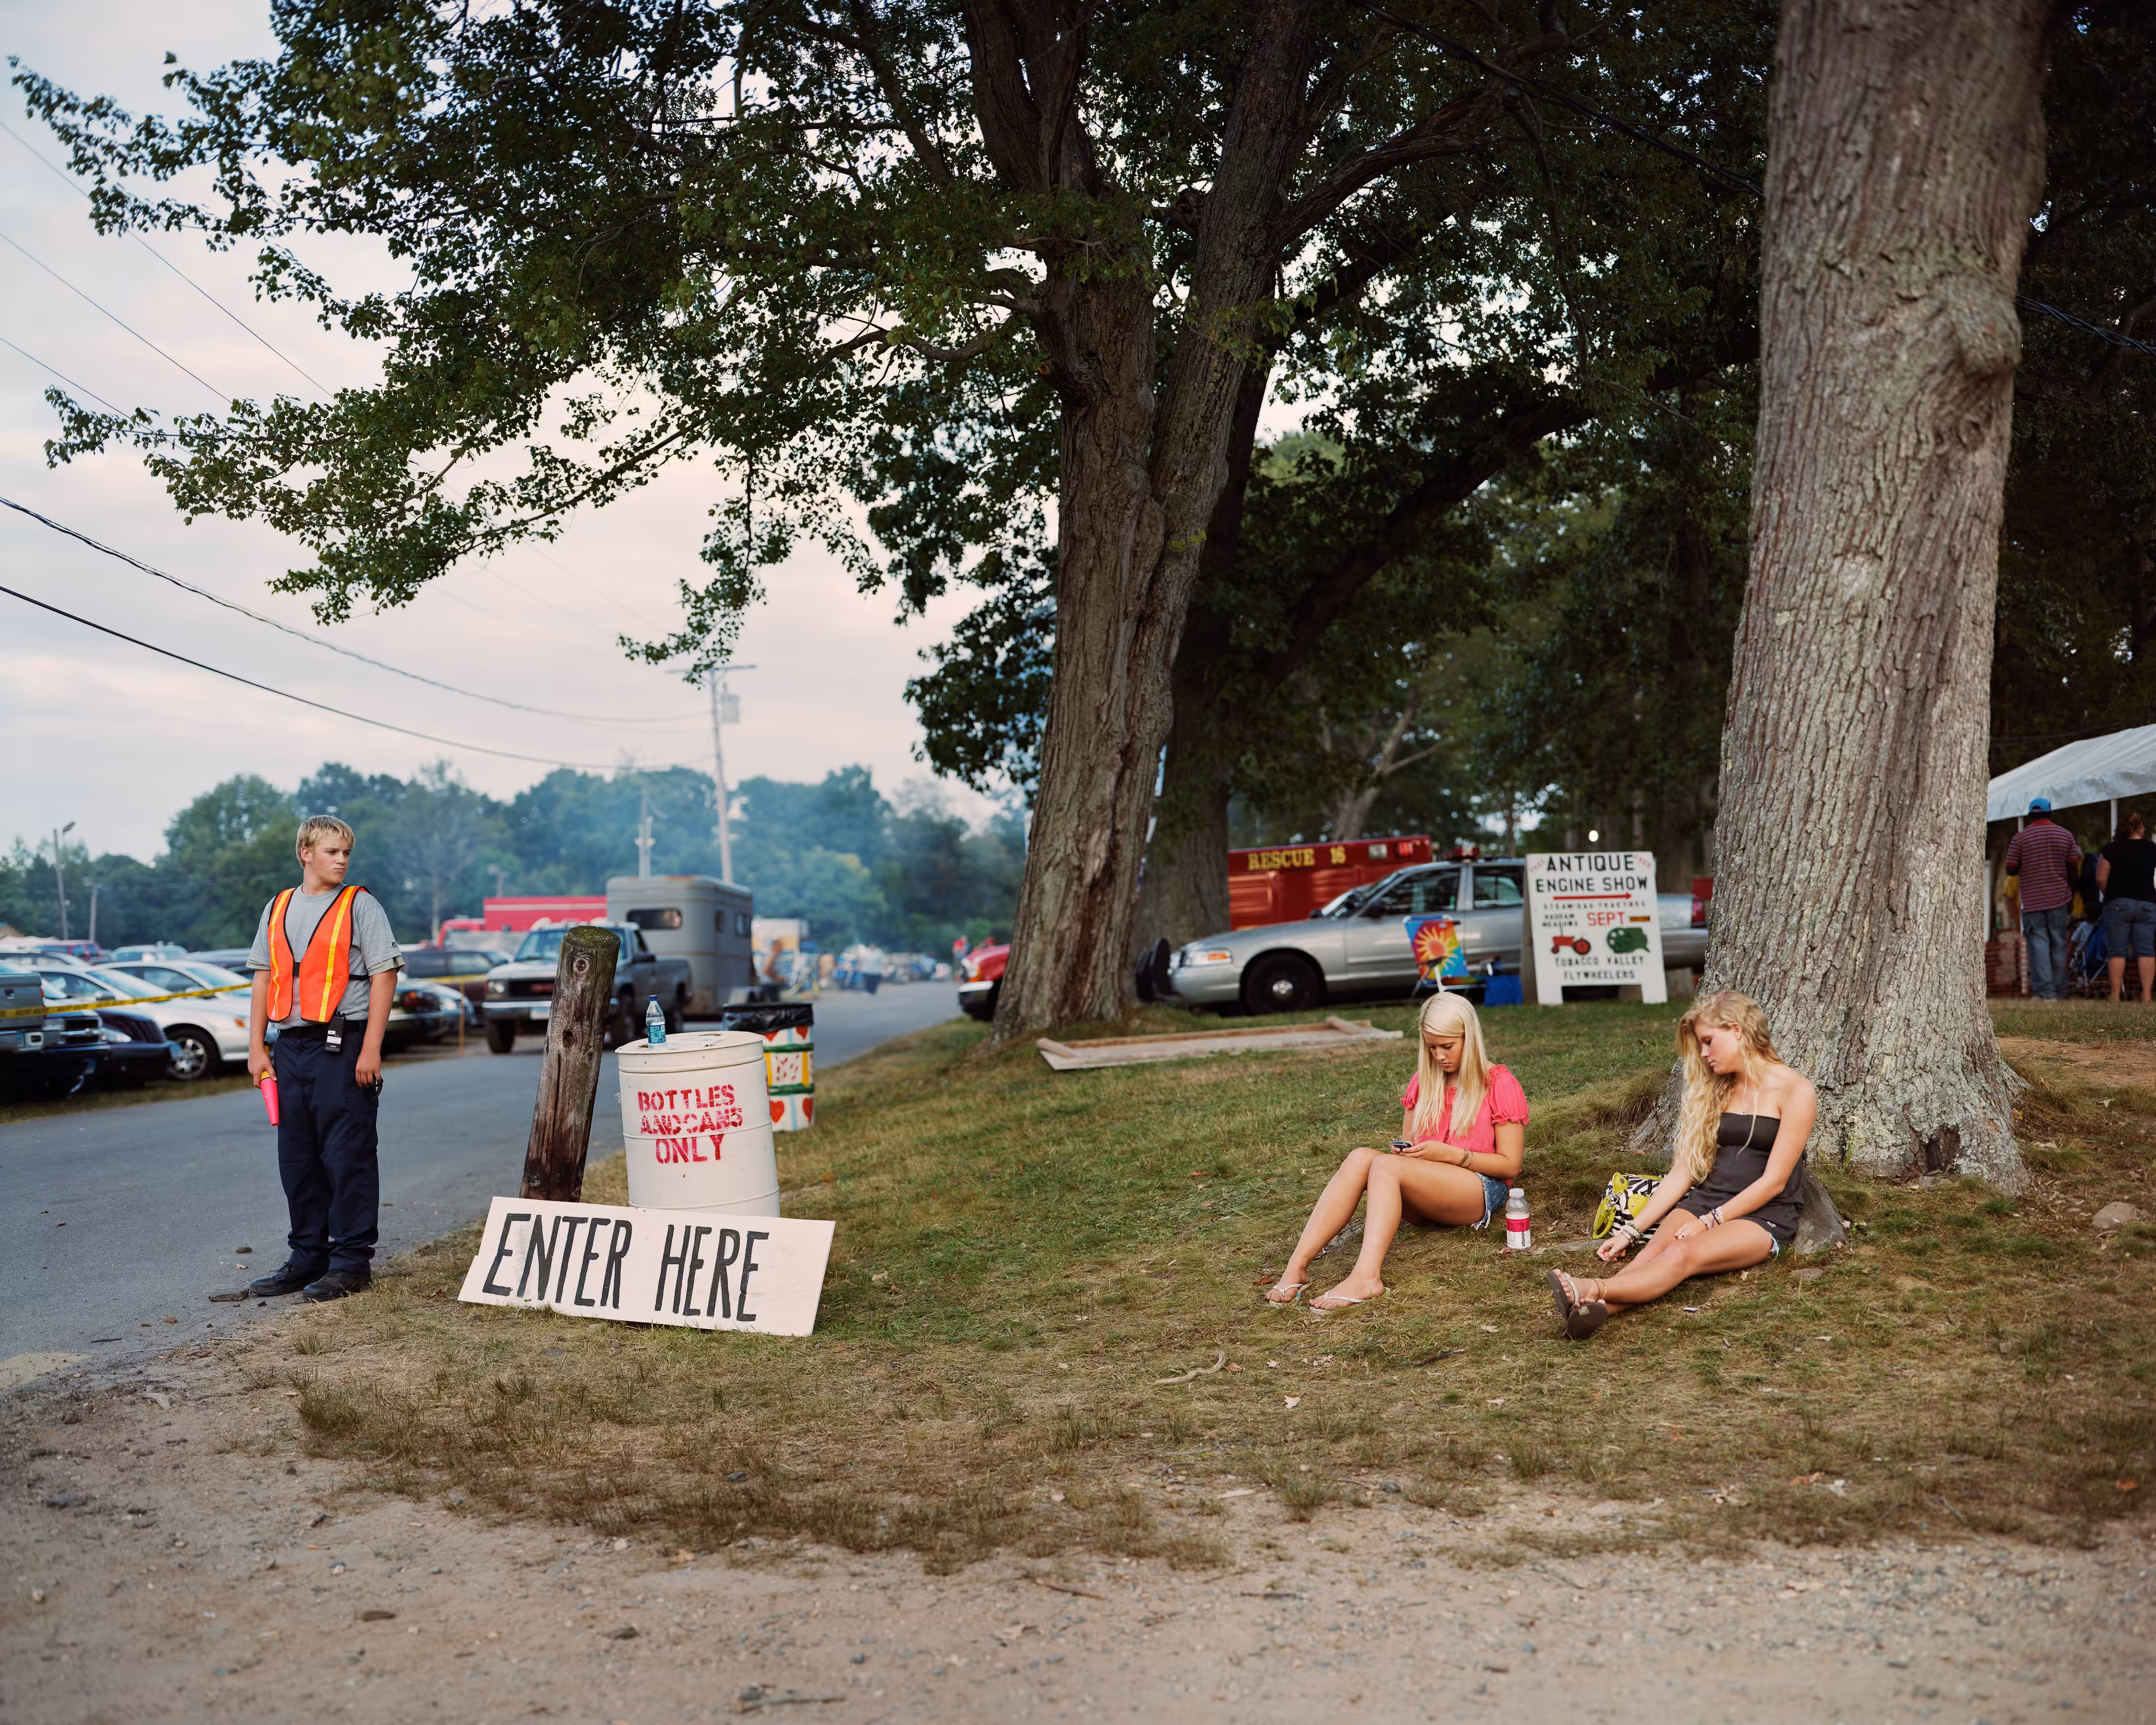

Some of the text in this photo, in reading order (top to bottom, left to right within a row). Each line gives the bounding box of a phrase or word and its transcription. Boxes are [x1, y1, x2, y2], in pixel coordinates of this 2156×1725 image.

[1248, 848, 1315, 870] RESCUE
[1547, 855, 1634, 871] ANTIQUE
[1536, 876, 1647, 892] ENGINE SHOW
[1587, 912, 1625, 926] SEPT
[1555, 955, 1644, 966] TOBACCO VALLEY
[1564, 970, 1635, 980] FLYWHEELERS
[638, 1084, 735, 1112] BOTTLES
[655, 1134, 725, 1164] ONLY
[482, 1213, 769, 1322] ENTER HERE
